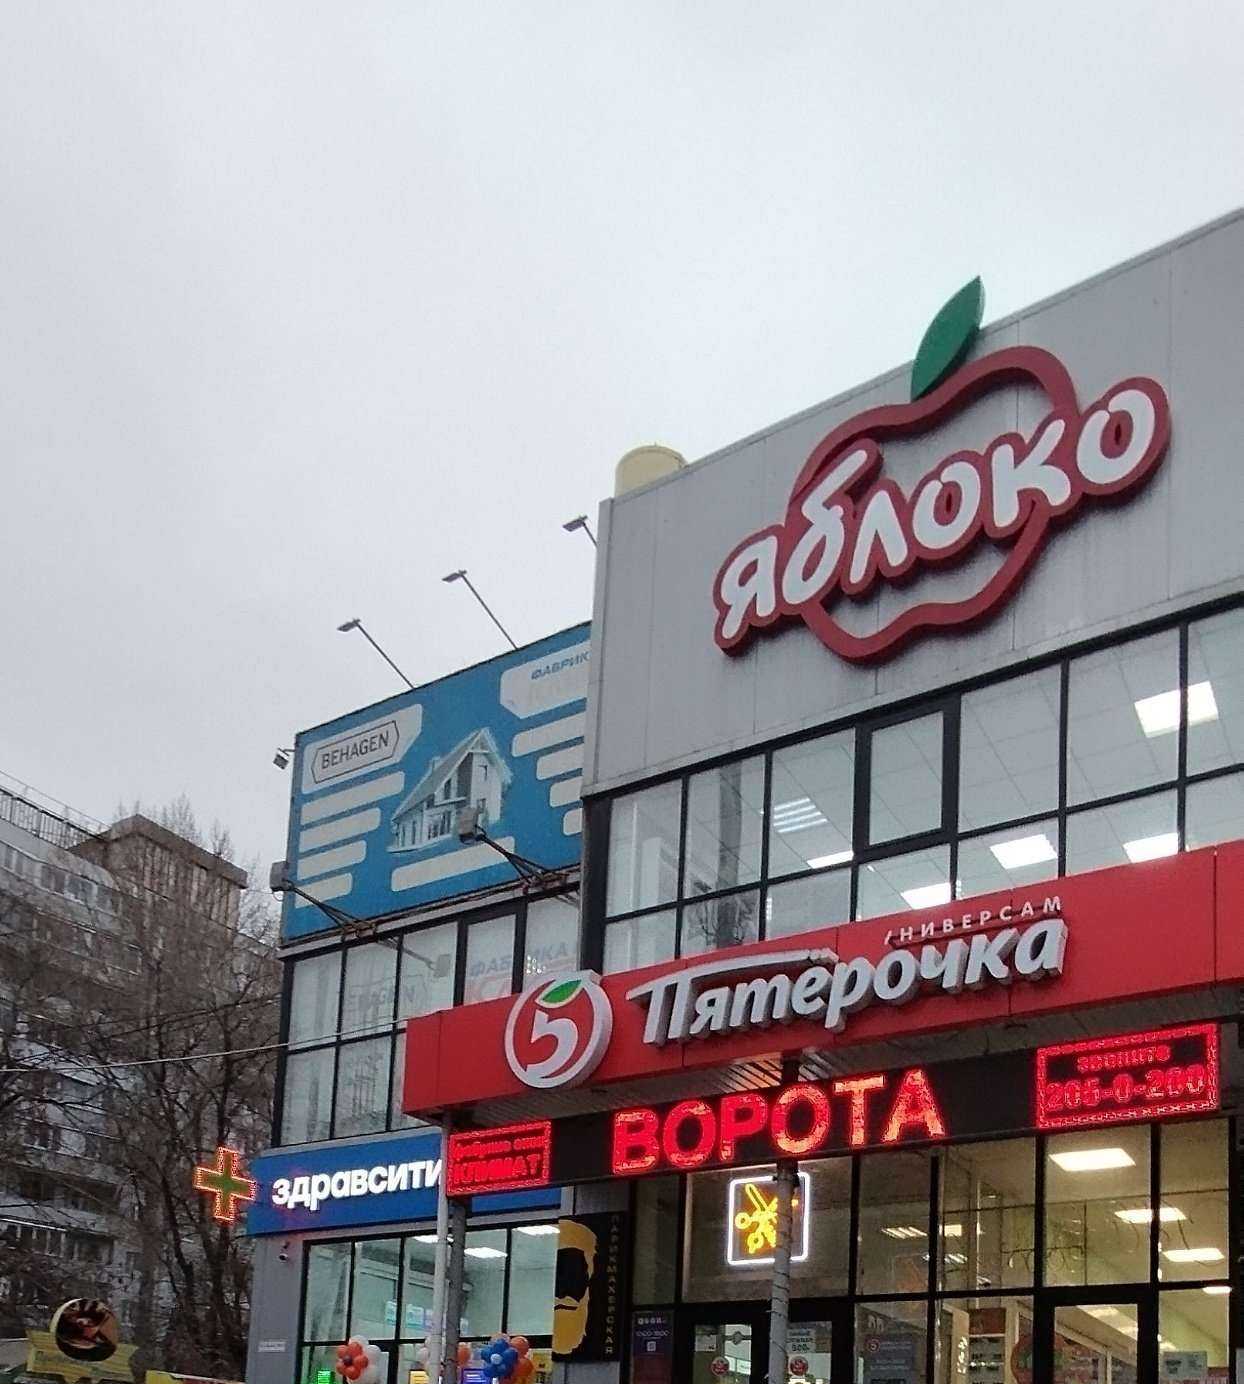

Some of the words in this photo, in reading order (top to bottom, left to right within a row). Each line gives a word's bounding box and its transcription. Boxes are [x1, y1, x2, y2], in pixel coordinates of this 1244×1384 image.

[531, 651, 591, 680] ФАБРИК
[320, 730, 390, 770] BEHAGEN
[1046, 1064, 1206, 1111] 205-0-200
[612, 1066, 946, 1176] ВОРОТА
[271, 1158, 442, 1211] здравсити
